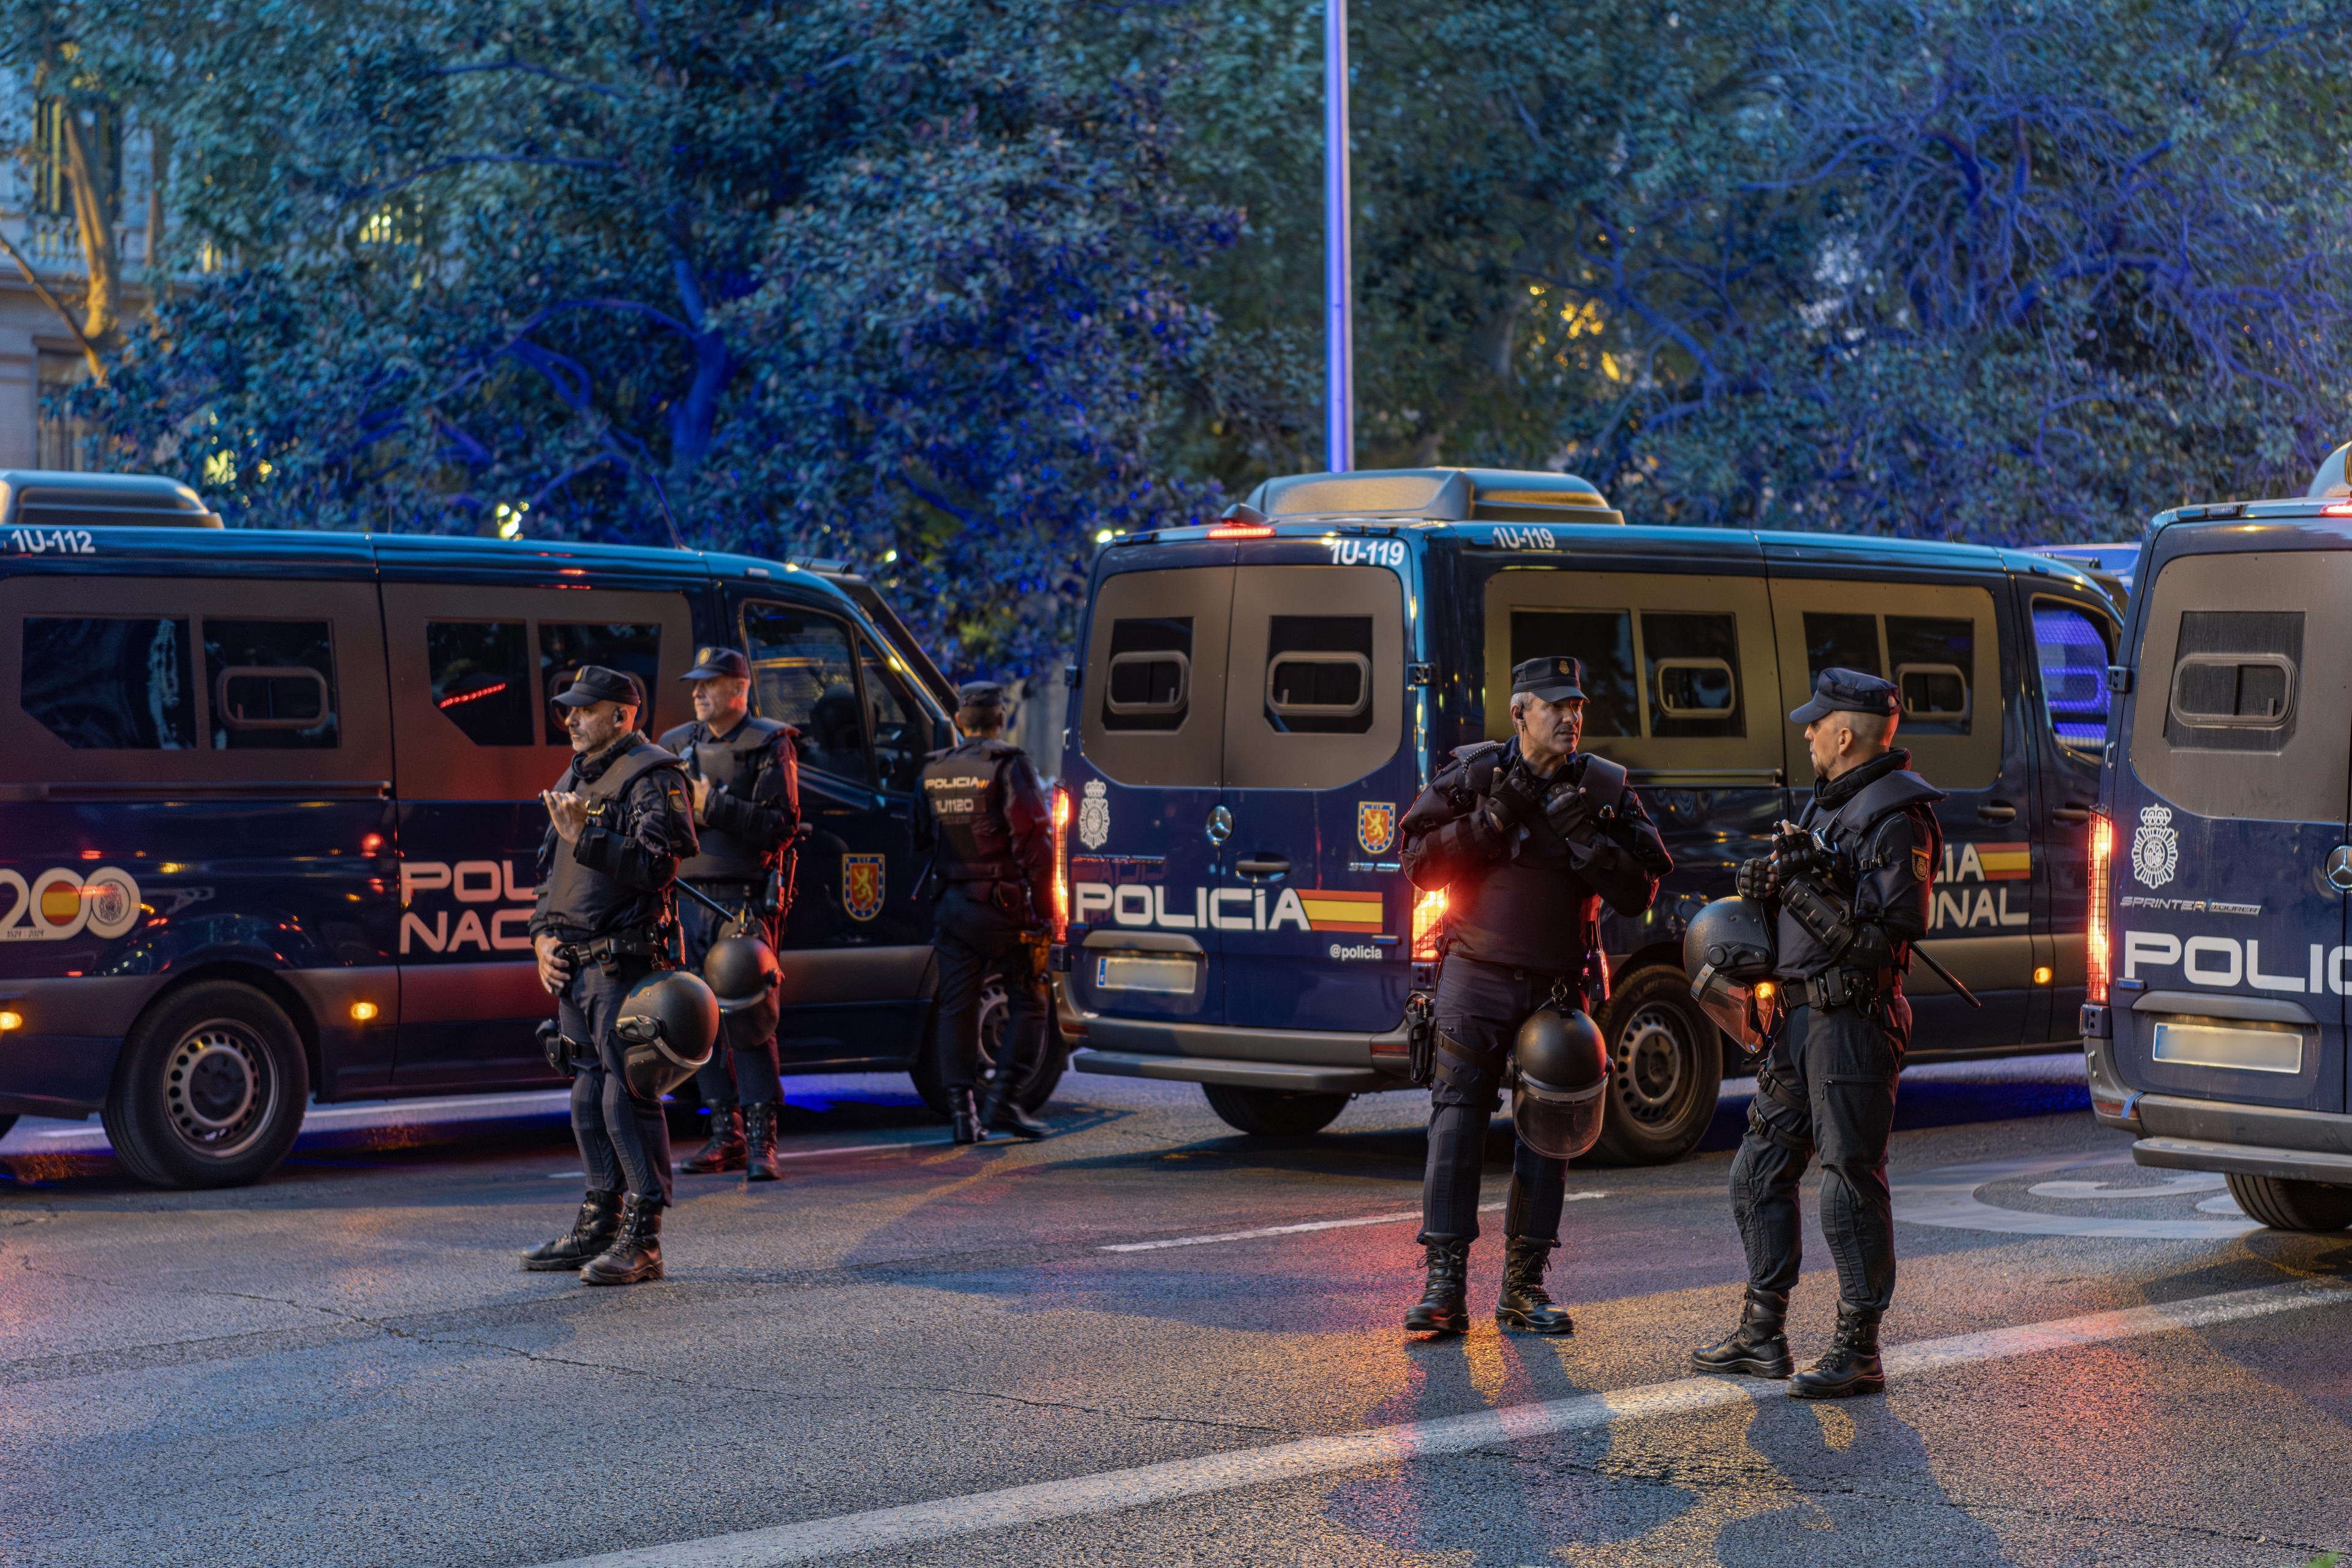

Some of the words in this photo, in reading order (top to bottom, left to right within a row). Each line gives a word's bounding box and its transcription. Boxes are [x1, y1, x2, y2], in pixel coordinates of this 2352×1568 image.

[11, 529, 96, 553] 1U-112
[1493, 527, 1556, 549] 1U-119
[1330, 541, 1404, 565] 1U-119
[400, 859, 539, 907] POL
[2120, 896, 2207, 913] SPRINTER
[399, 909, 535, 954] NAC
[1329, 944, 1382, 962] @policia
